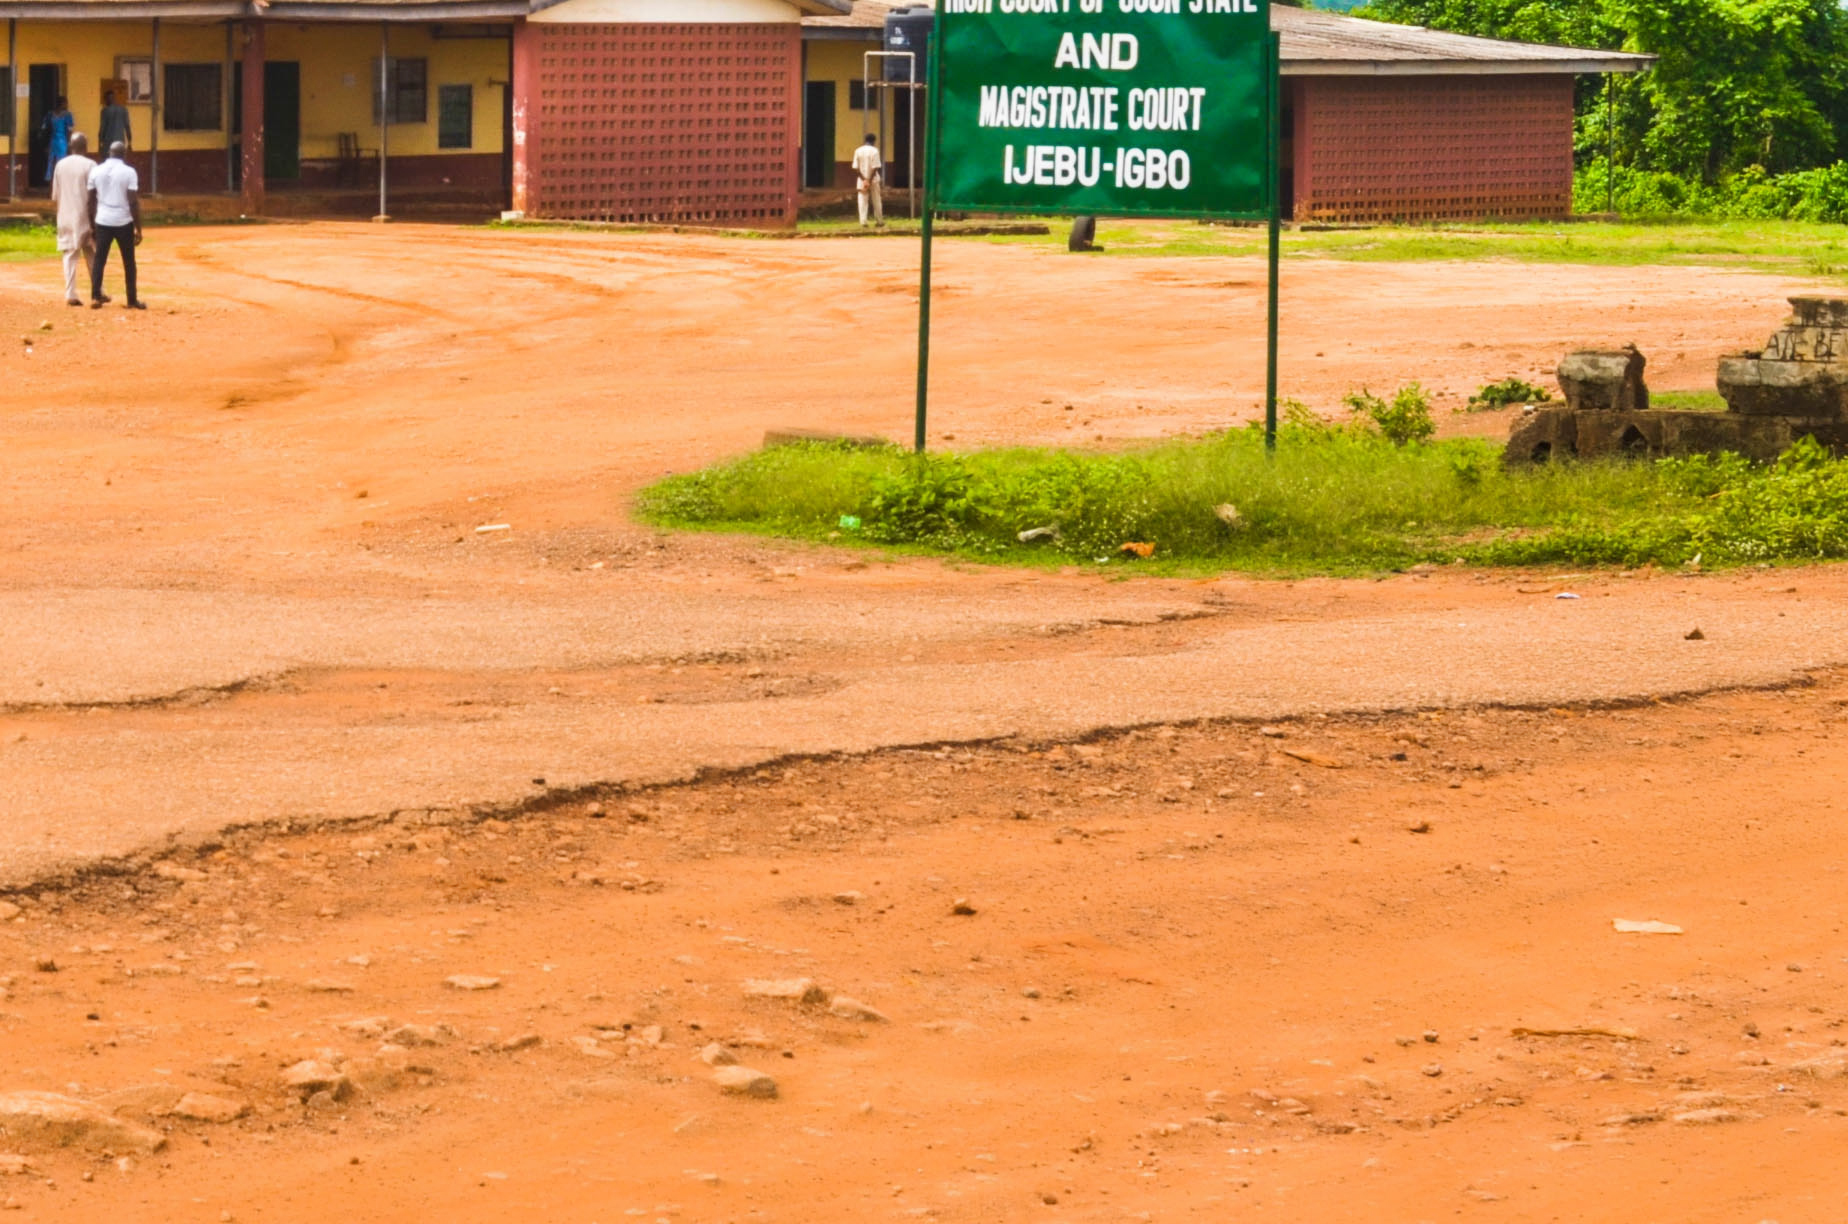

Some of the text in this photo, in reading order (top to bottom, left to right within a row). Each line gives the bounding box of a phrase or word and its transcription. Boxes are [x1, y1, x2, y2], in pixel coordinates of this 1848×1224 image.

[1054, 31, 1139, 70] AND
[978, 85, 1206, 131] MAGISTRATE COURT
[1003, 144, 1191, 190] IJEBU-IGBO
